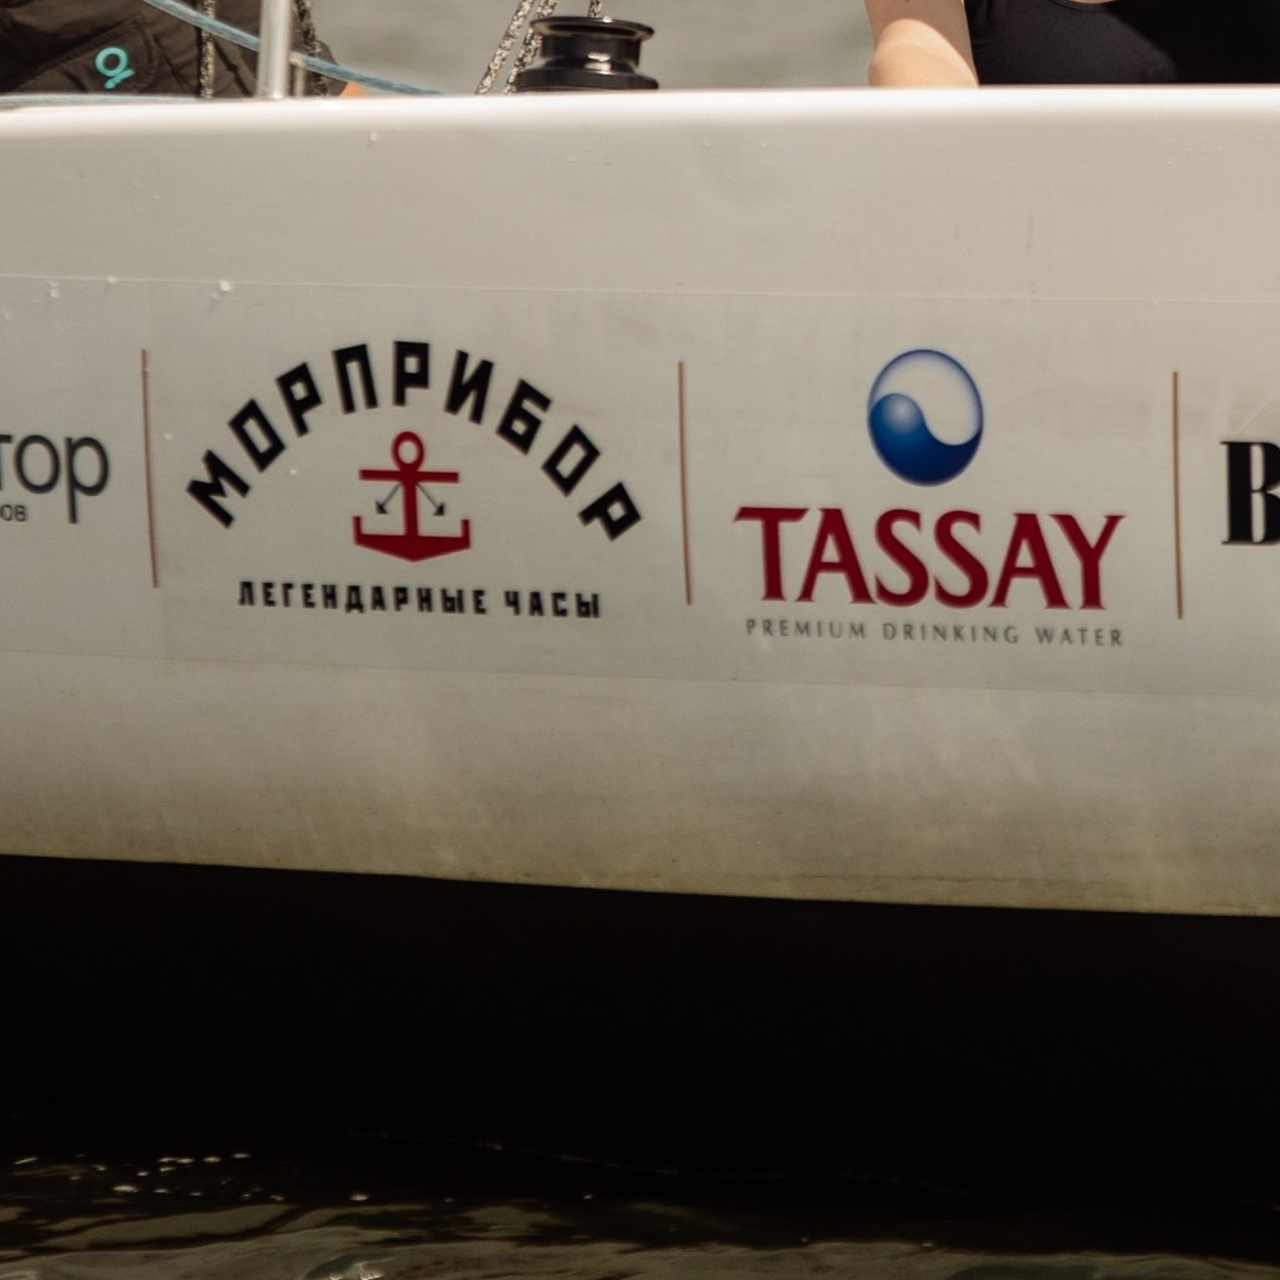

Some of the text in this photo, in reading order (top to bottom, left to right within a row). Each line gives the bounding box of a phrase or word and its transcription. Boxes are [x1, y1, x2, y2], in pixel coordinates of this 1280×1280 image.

[185, 339, 642, 542] МОРПРИБОР
[733, 506, 1126, 611] TASSAY
[238, 580, 601, 619] ЛЕГЕНДАРНЫЕ ЧАСЫ
[745, 617, 1123, 647] PREMIUM DRINKING WATER
